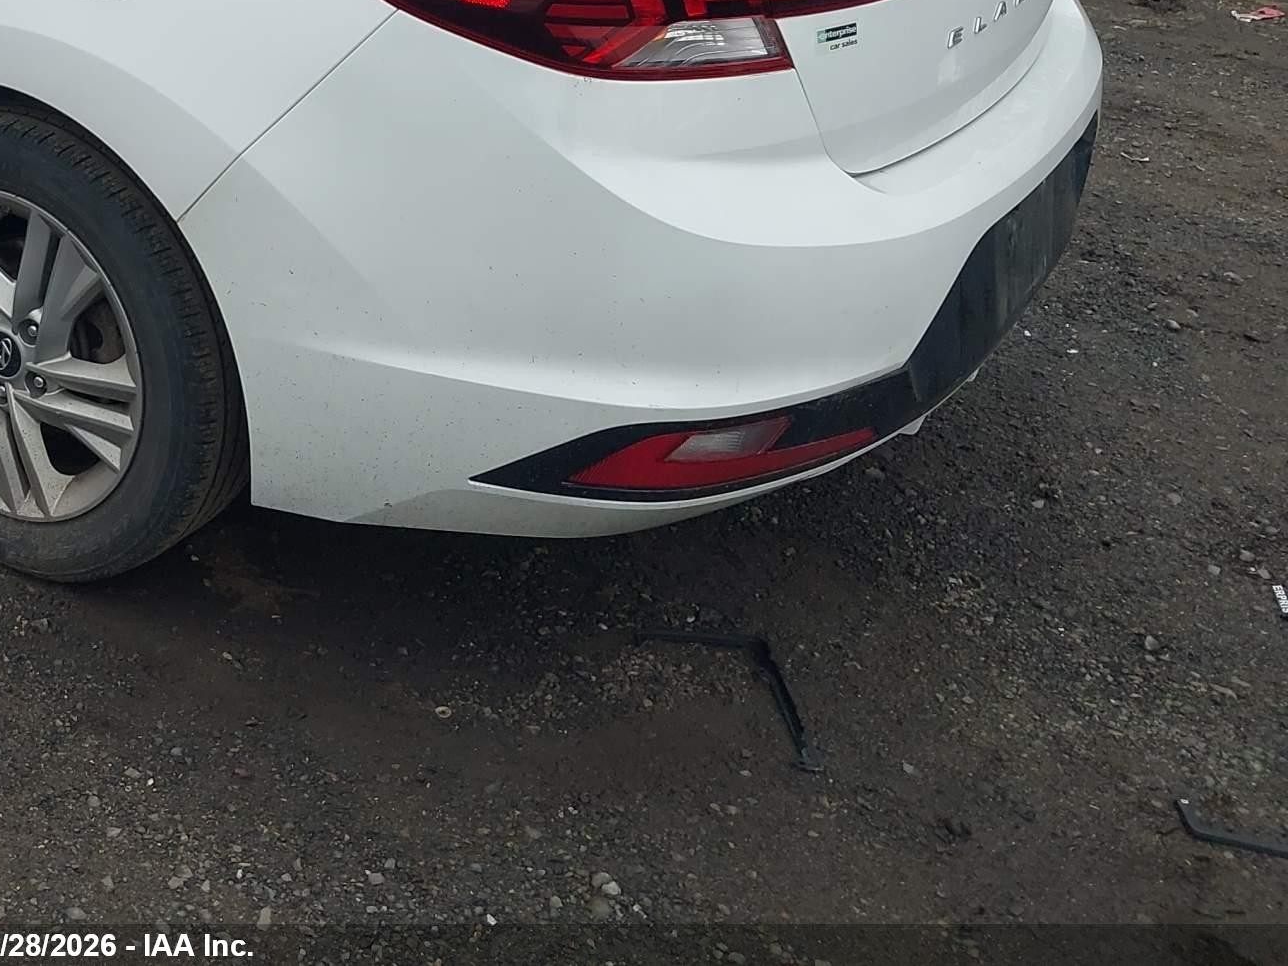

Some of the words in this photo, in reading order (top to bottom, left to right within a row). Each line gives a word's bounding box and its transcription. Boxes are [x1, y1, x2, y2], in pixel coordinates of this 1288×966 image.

[817, 24, 858, 41] enterprise
[829, 42, 841, 51] car
[841, 38, 858, 48] sales
